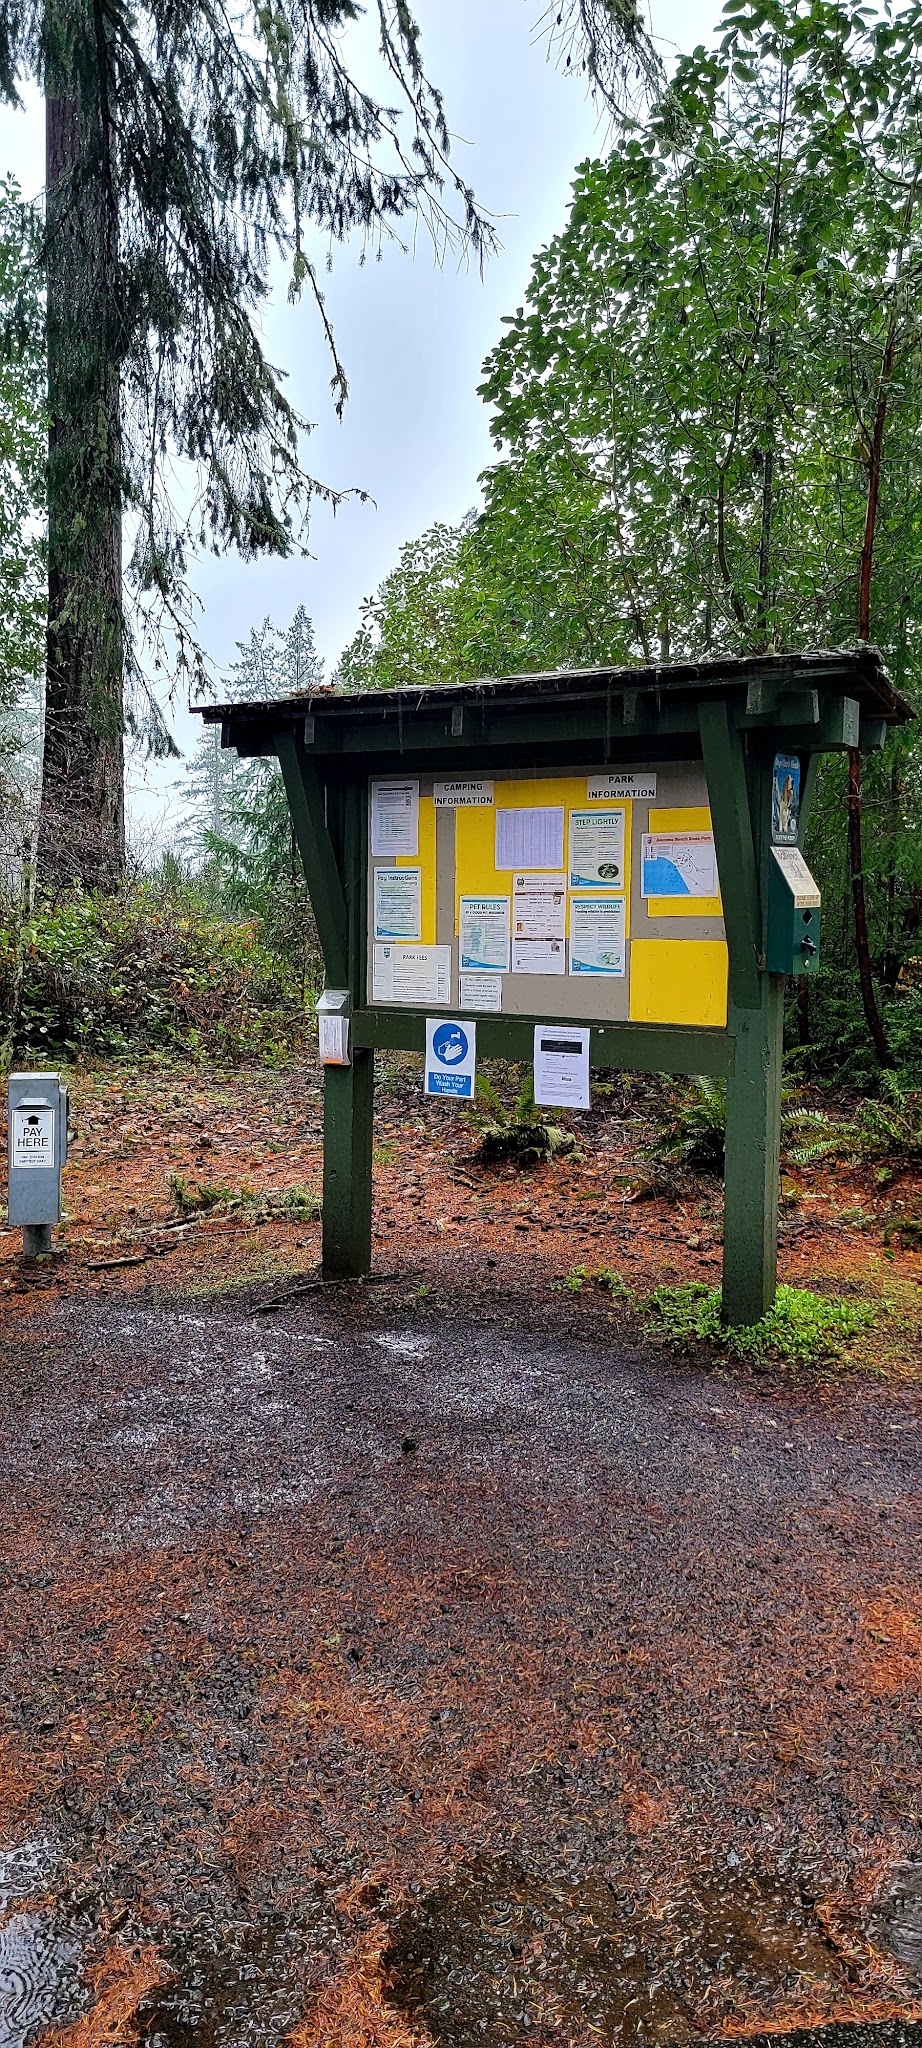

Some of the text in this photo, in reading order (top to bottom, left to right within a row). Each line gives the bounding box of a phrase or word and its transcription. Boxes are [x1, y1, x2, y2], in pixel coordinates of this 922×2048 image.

[608, 775, 635, 784] PARK
[443, 783, 483, 792] CAMPING
[588, 789, 655, 799] INFORMATION
[434, 796, 493, 805] INFORMATION
[481, 903, 501, 911] RULES
[23, 1127, 43, 1137] PAY
[17, 1137, 49, 1147] HERE
